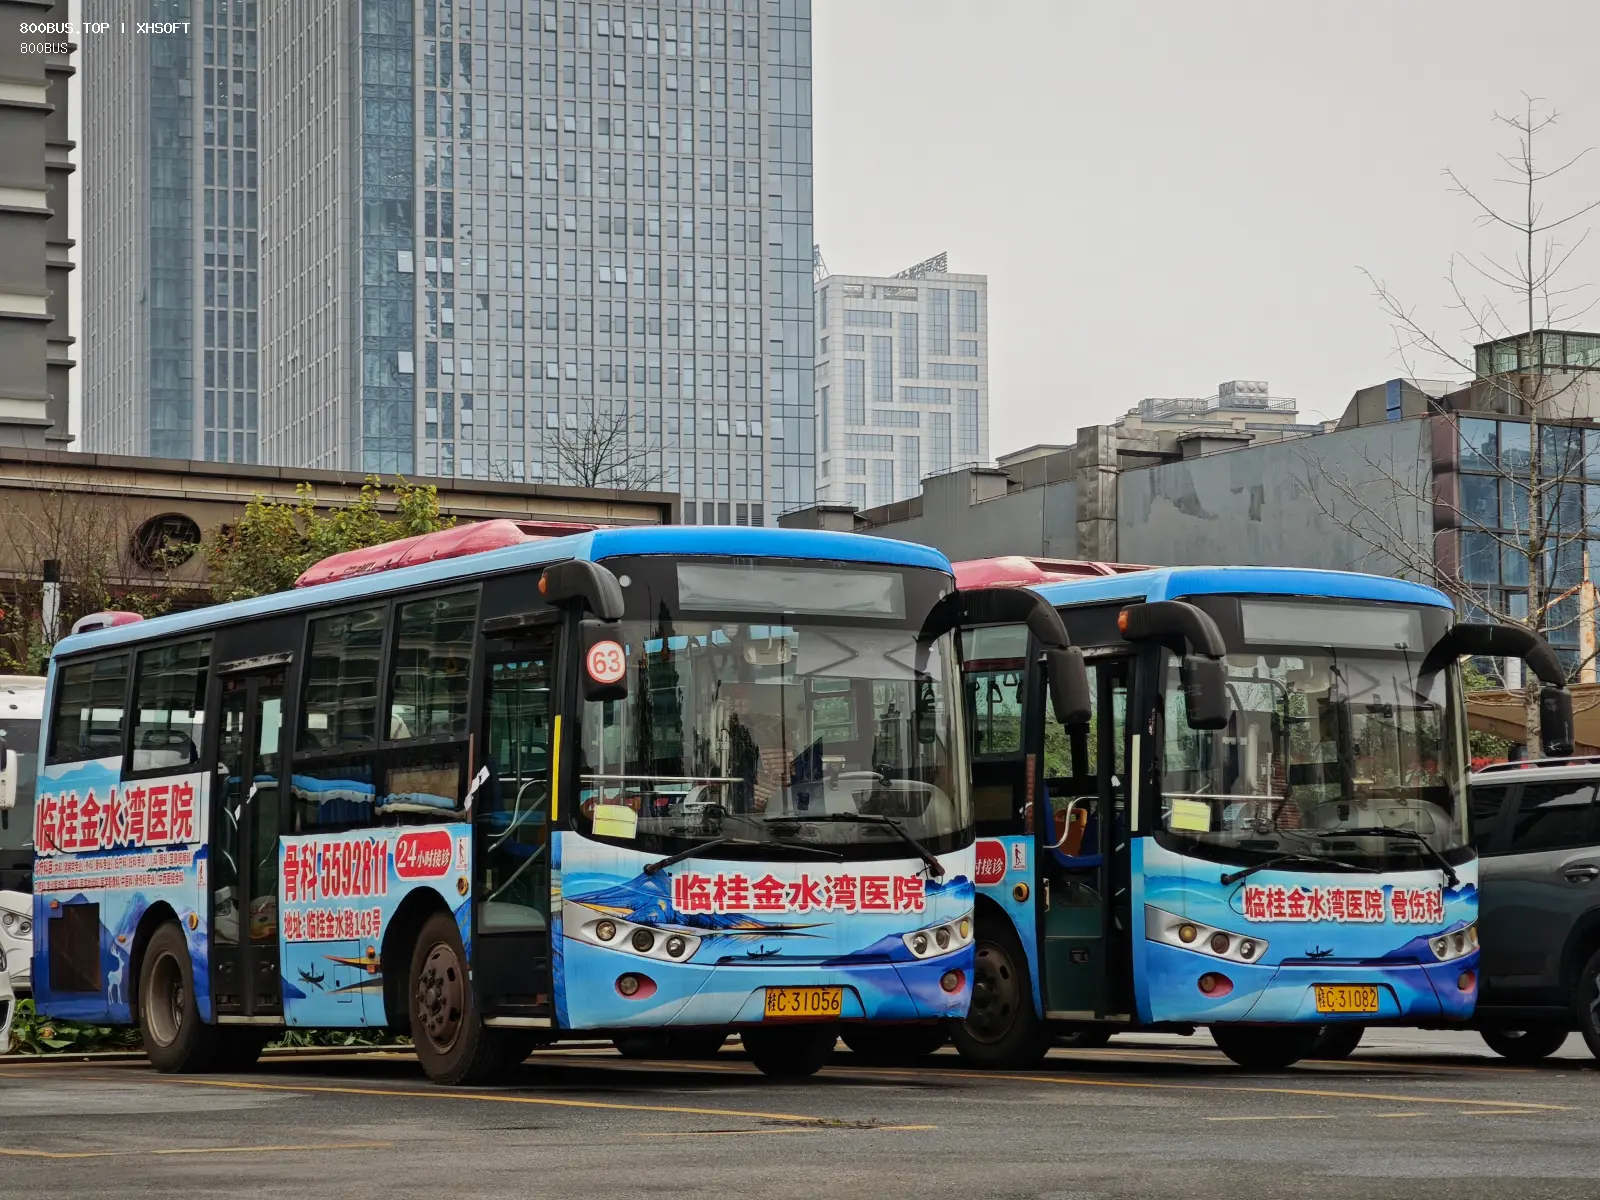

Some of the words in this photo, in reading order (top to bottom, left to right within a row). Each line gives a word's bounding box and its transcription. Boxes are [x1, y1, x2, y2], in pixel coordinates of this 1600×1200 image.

[592, 649, 622, 675] 63
[35, 780, 195, 852] 临桂金水湾医院
[283, 840, 318, 902] 骨科
[321, 838, 389, 898] 5592811
[674, 873, 926, 912] 临桂金水湾医院
[1244, 887, 1384, 919] 临桂金水湾医院
[1391, 888, 1443, 921] 骨伤科
